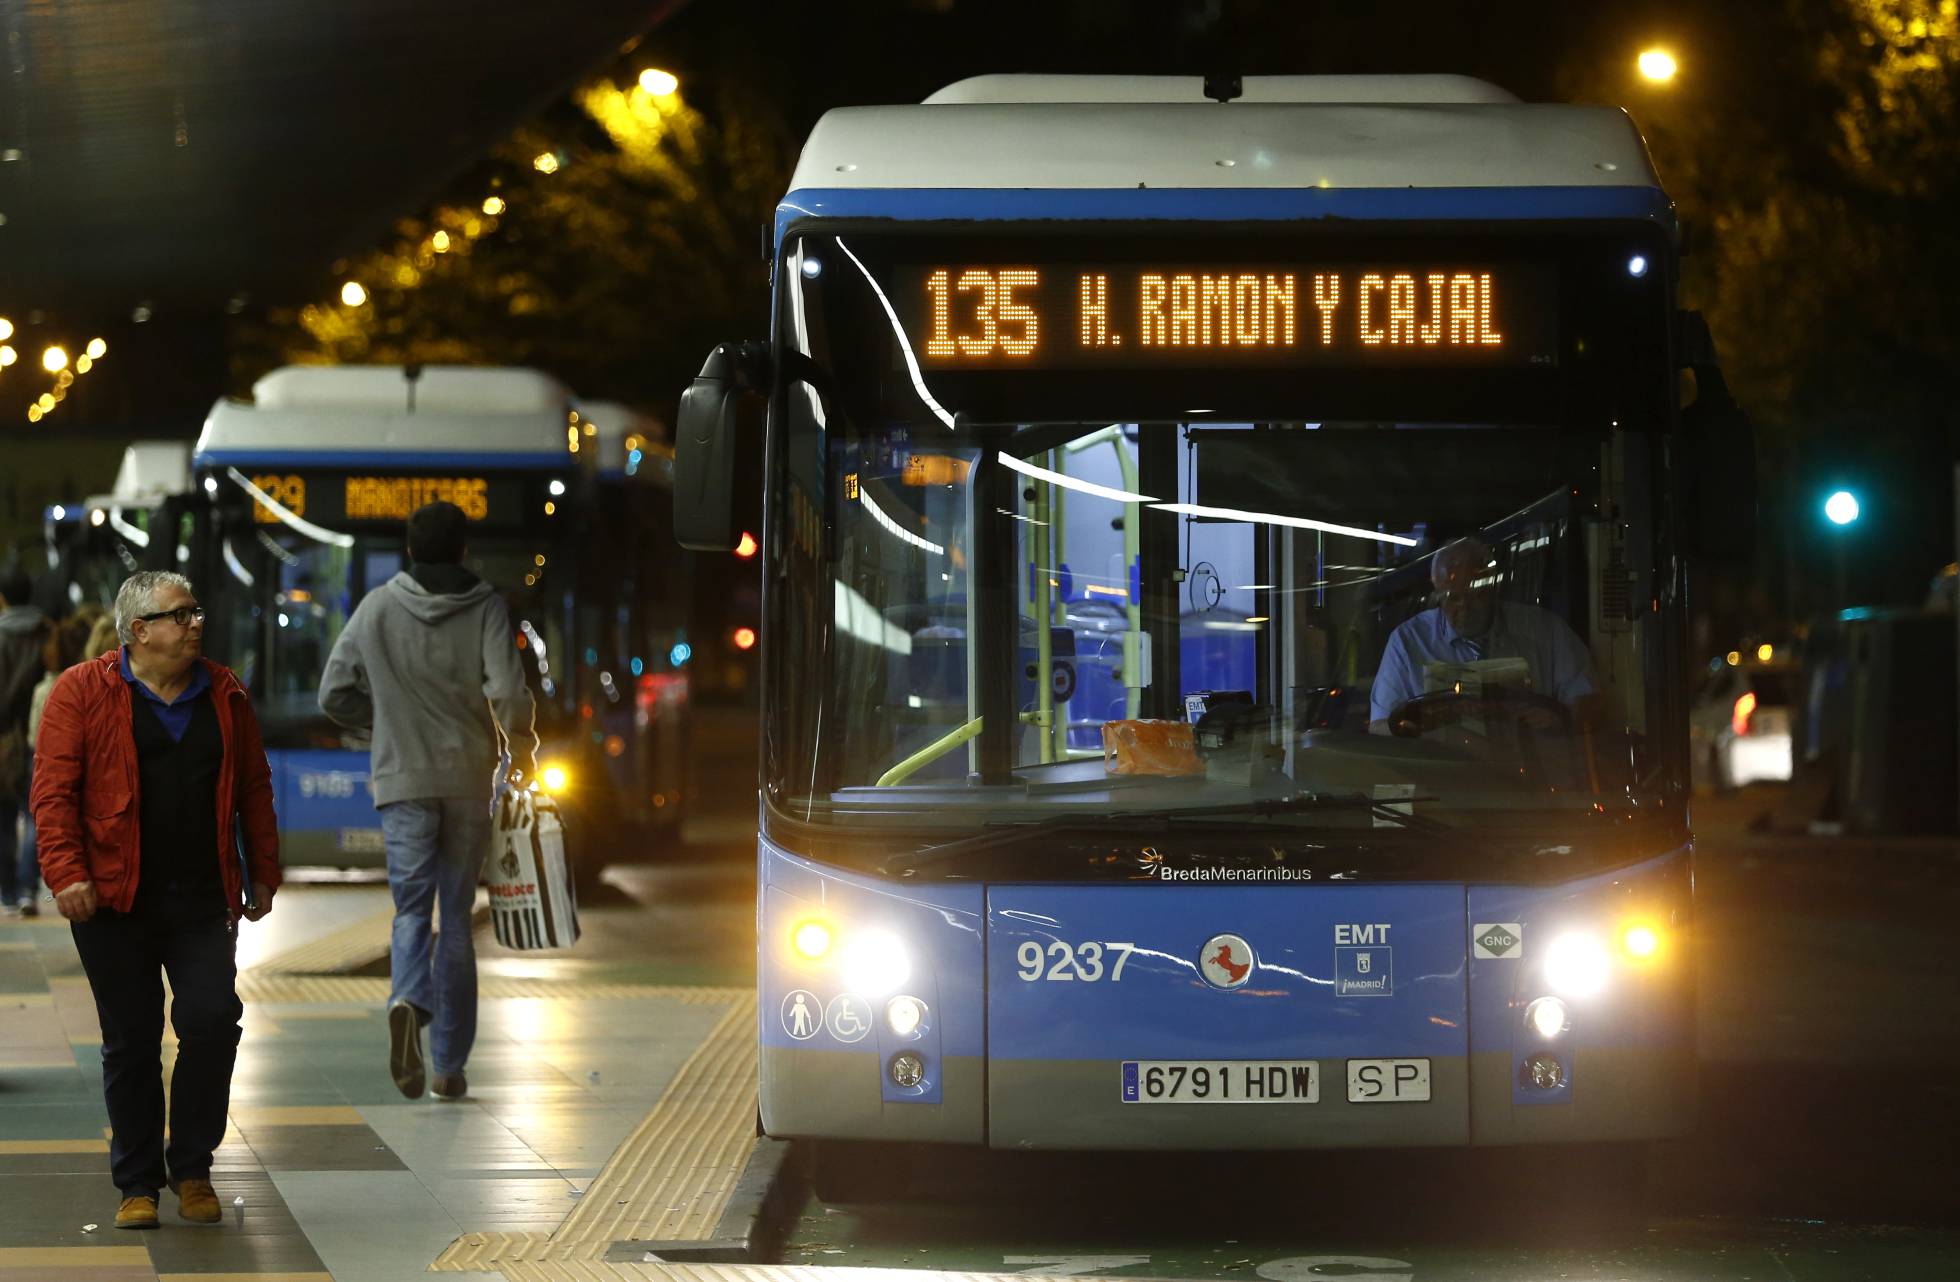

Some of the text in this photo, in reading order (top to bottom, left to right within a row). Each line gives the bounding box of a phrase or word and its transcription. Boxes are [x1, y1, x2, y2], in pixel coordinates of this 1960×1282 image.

[928, 270, 1501, 356] 135 H. RAMON Y CAJAL
[1161, 866, 1312, 881] BredaMenarinibus
[1335, 924, 1392, 944] EMT
[1484, 936, 1512, 946] GNC
[1016, 941, 1134, 982] 9237
[1127, 1066, 1310, 1098] E 6791 HDW
